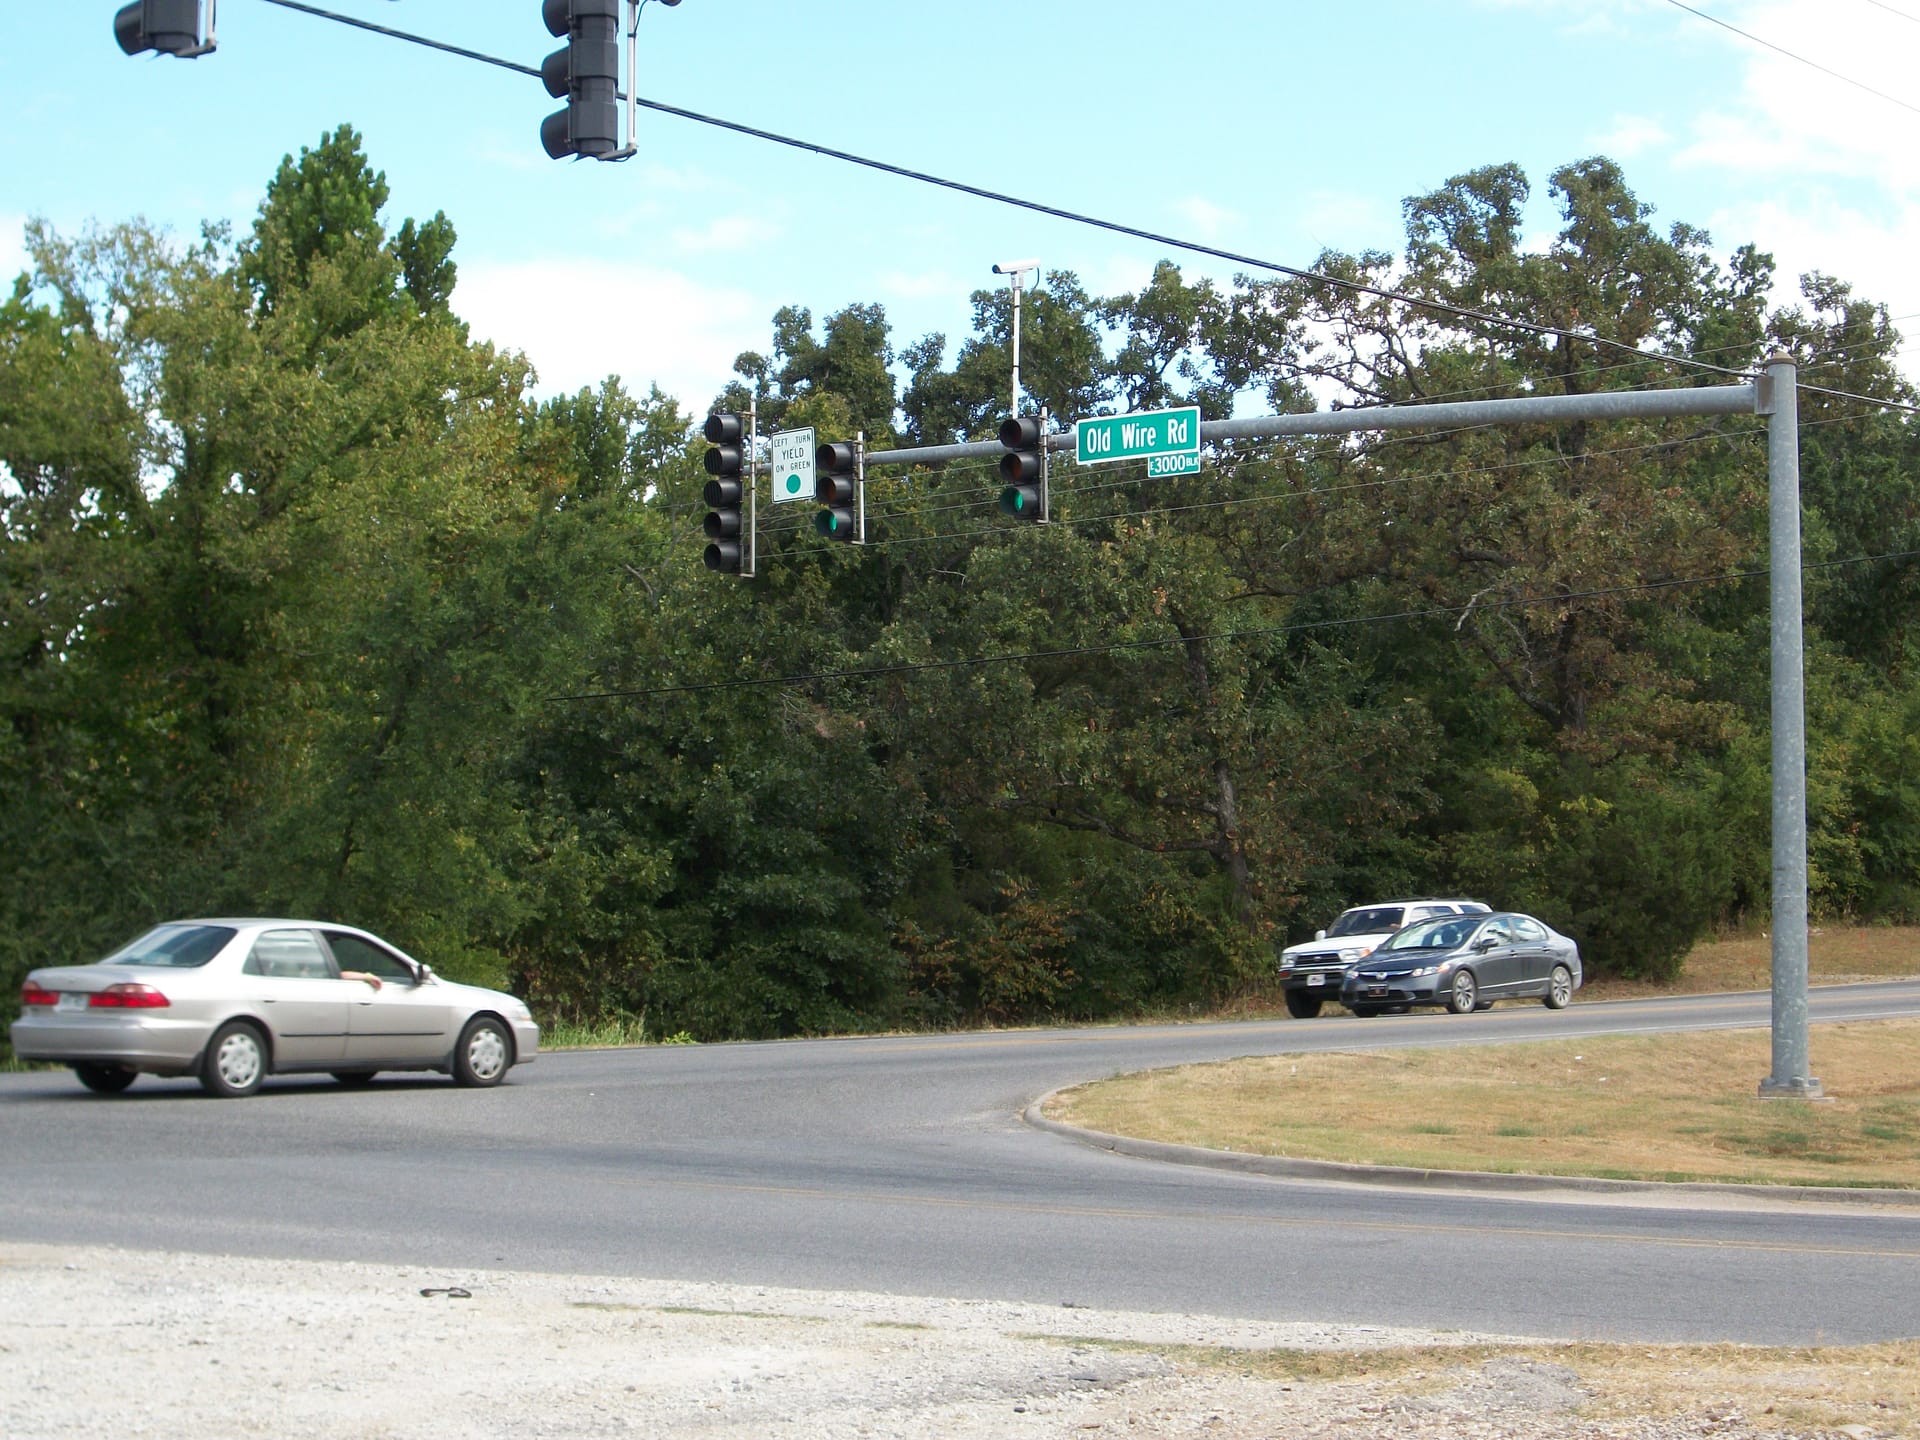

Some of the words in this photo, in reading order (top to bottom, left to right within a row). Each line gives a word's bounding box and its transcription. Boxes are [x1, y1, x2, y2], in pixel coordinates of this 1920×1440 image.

[774, 438, 788, 448] LEFT
[795, 433, 811, 444] TURN
[1087, 426, 1111, 454] Old
[1121, 423, 1157, 449] Wire
[1167, 418, 1188, 444] Rd
[782, 447, 804, 460] YIELD
[775, 464, 785, 473] ON
[790, 460, 811, 471] GREEN
[1154, 455, 1185, 473] 3000
